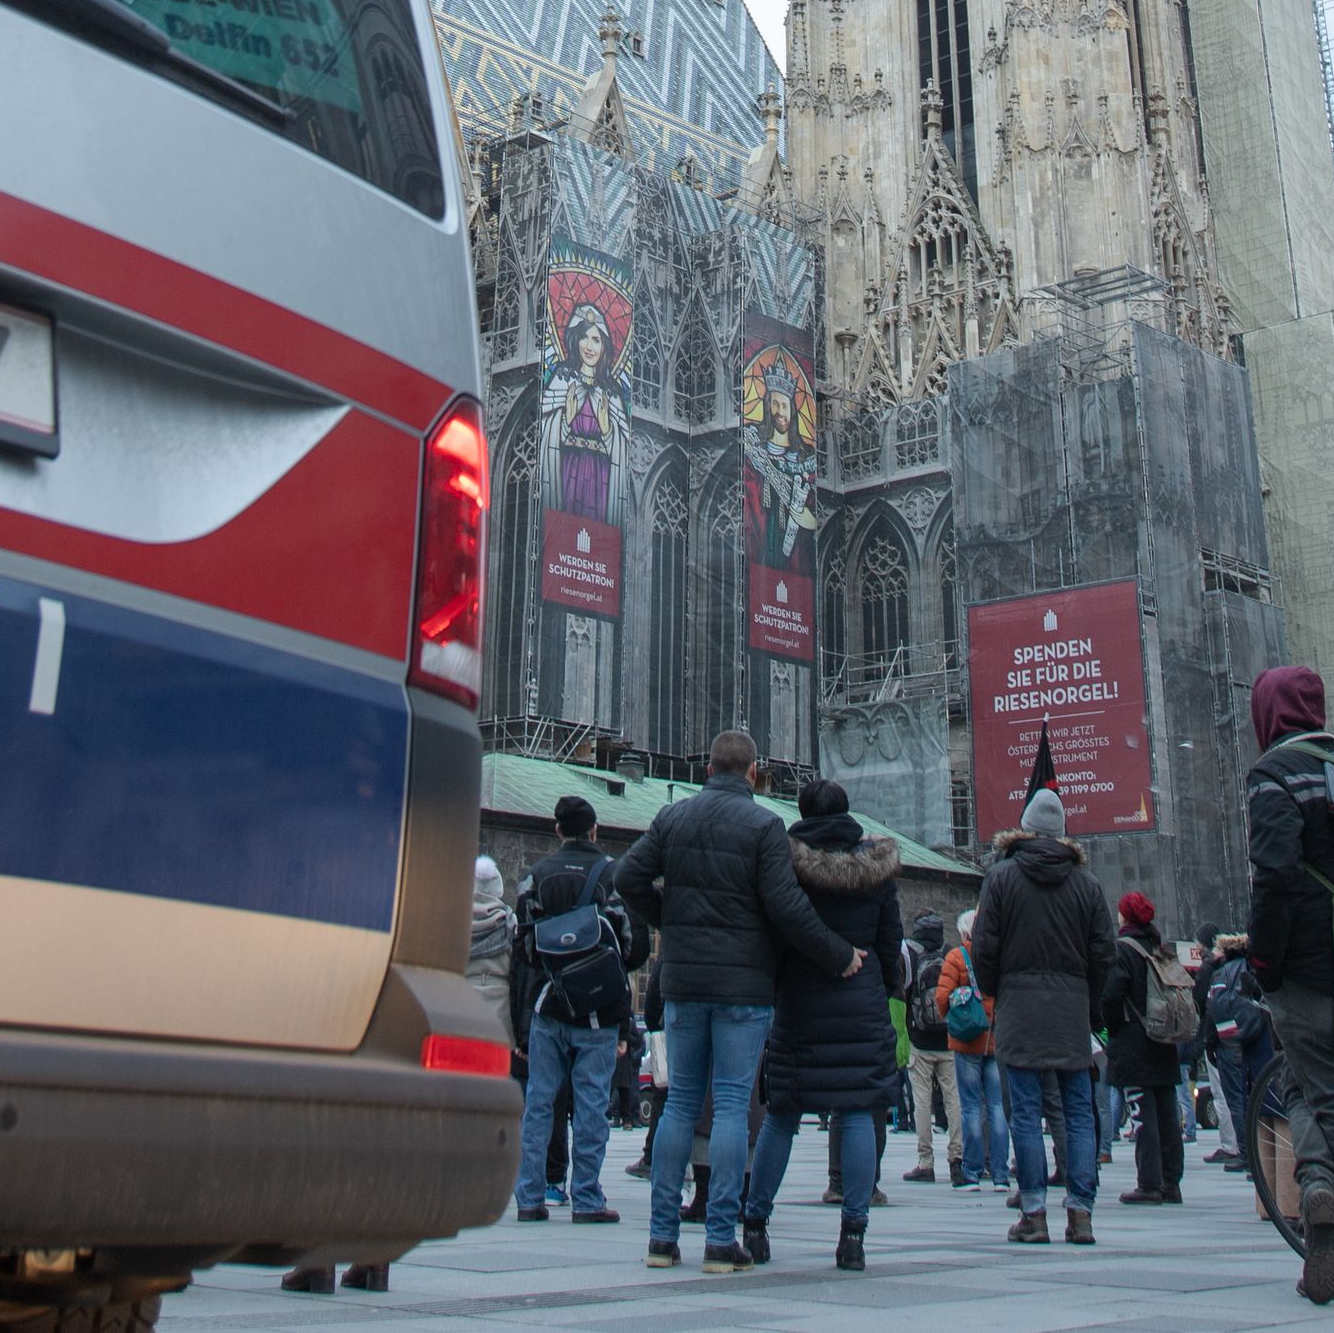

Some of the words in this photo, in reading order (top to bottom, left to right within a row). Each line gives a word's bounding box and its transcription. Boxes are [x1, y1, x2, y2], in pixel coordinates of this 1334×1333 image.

[558, 552, 594, 570] WERDEN
[594, 561, 607, 575] SIE
[548, 563, 615, 589] SCHUTZPATRON!
[761, 603, 792, 619] WERDEN
[791, 611, 803, 622] SIE
[754, 613, 810, 636] SCHUTZPATRON!
[1013, 637, 1092, 665] SPENDEN
[1007, 669, 1032, 689] SIE
[1035, 661, 1069, 685] FÜR
[1073, 659, 1102, 680] DIE
[994, 681, 1119, 713] RIESENORGEL!
[1052, 727, 1069, 738] WIR
[1070, 724, 1095, 737] JETZT
[1065, 735, 1110, 750] GRÖSSTES
[1071, 784, 1089, 795] 1199
[1090, 782, 1114, 793] 6700
